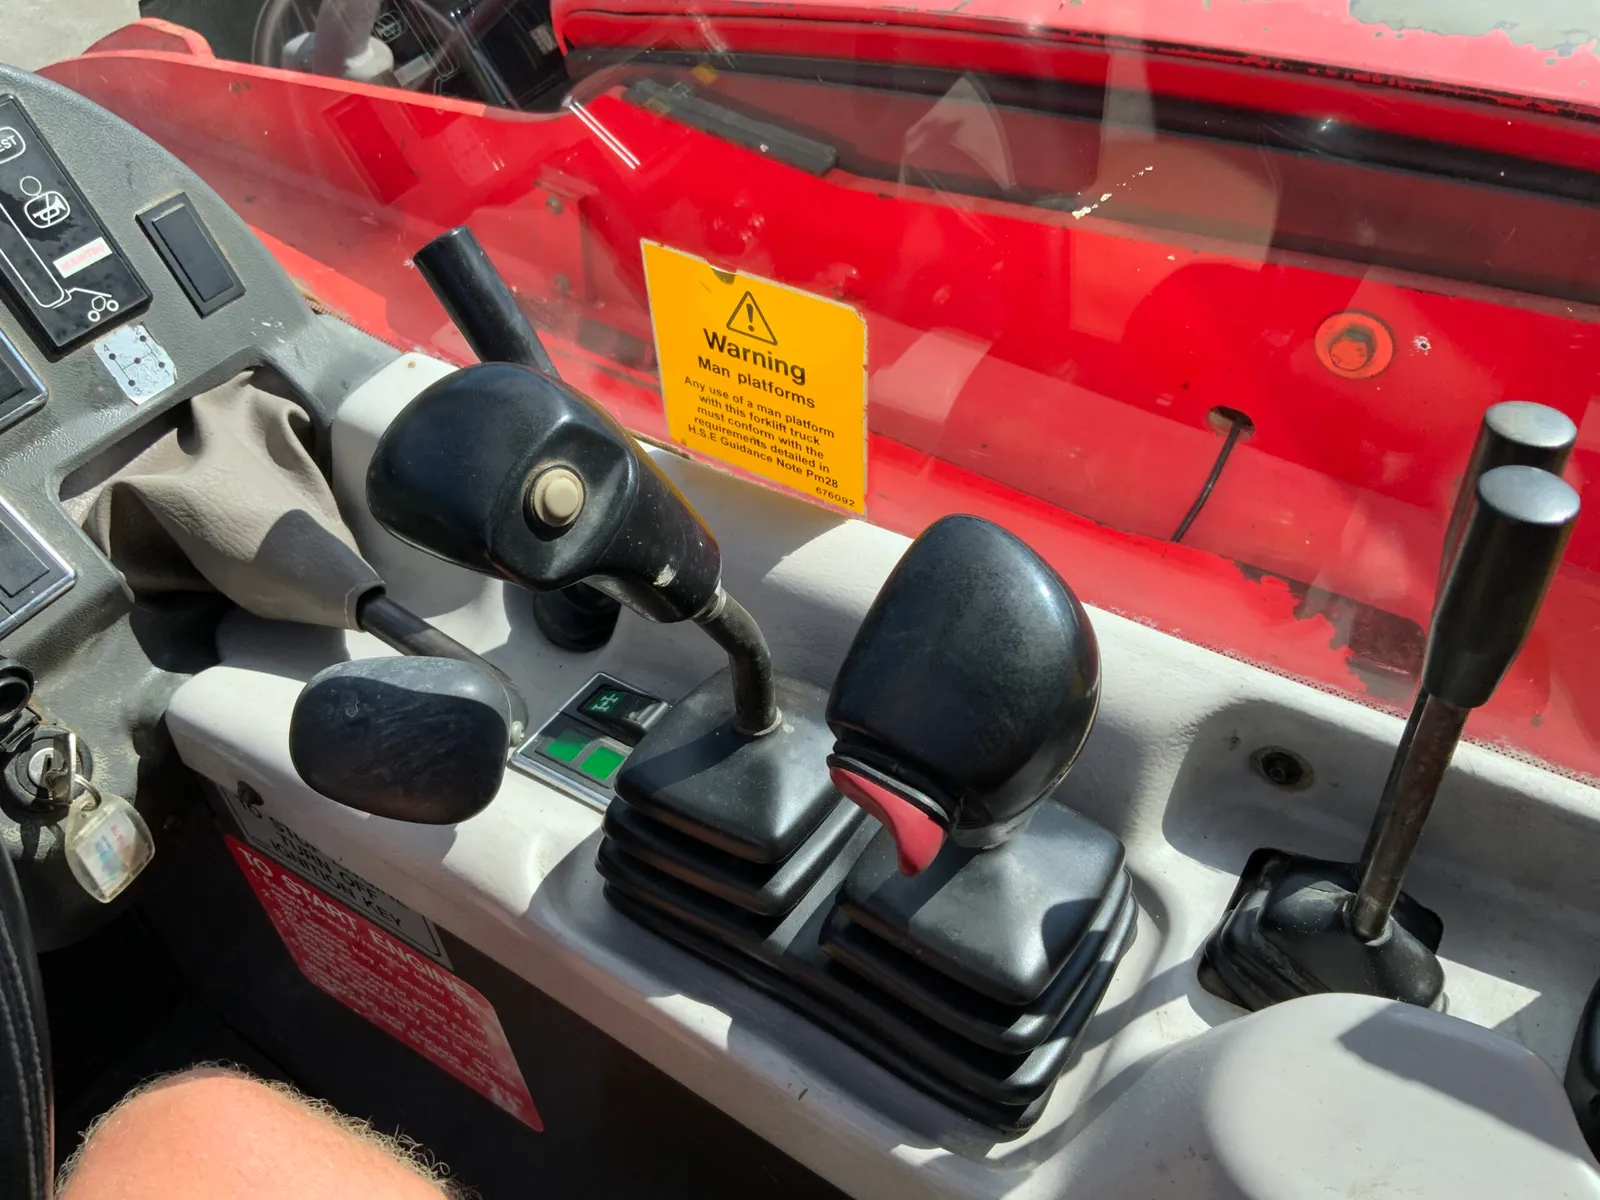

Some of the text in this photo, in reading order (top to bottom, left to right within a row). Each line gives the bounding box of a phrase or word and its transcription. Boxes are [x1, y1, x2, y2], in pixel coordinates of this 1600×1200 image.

[103, 344, 110, 352] 4
[703, 328, 806, 386] Warning
[133, 386, 142, 396] 3
[685, 376, 834, 438] Any use of a man platform
[698, 356, 815, 409] Man platforms
[694, 416, 829, 473] requirements detailed in
[698, 406, 824, 459] must conform with the
[699, 395, 820, 445] with this forklift truck
[721, 437, 772, 463] Guidance
[777, 457, 803, 475] Note
[806, 469, 838, 488] Pm28
[816, 487, 854, 507] 676092
[270, 839, 355, 898] IGNITION
[363, 897, 400, 926] KEY
[276, 832, 331, 872] TURN
[339, 871, 376, 898] OFF
[237, 847, 272, 876] TO
[281, 875, 356, 929] START
[368, 929, 471, 1002] ENGINE
